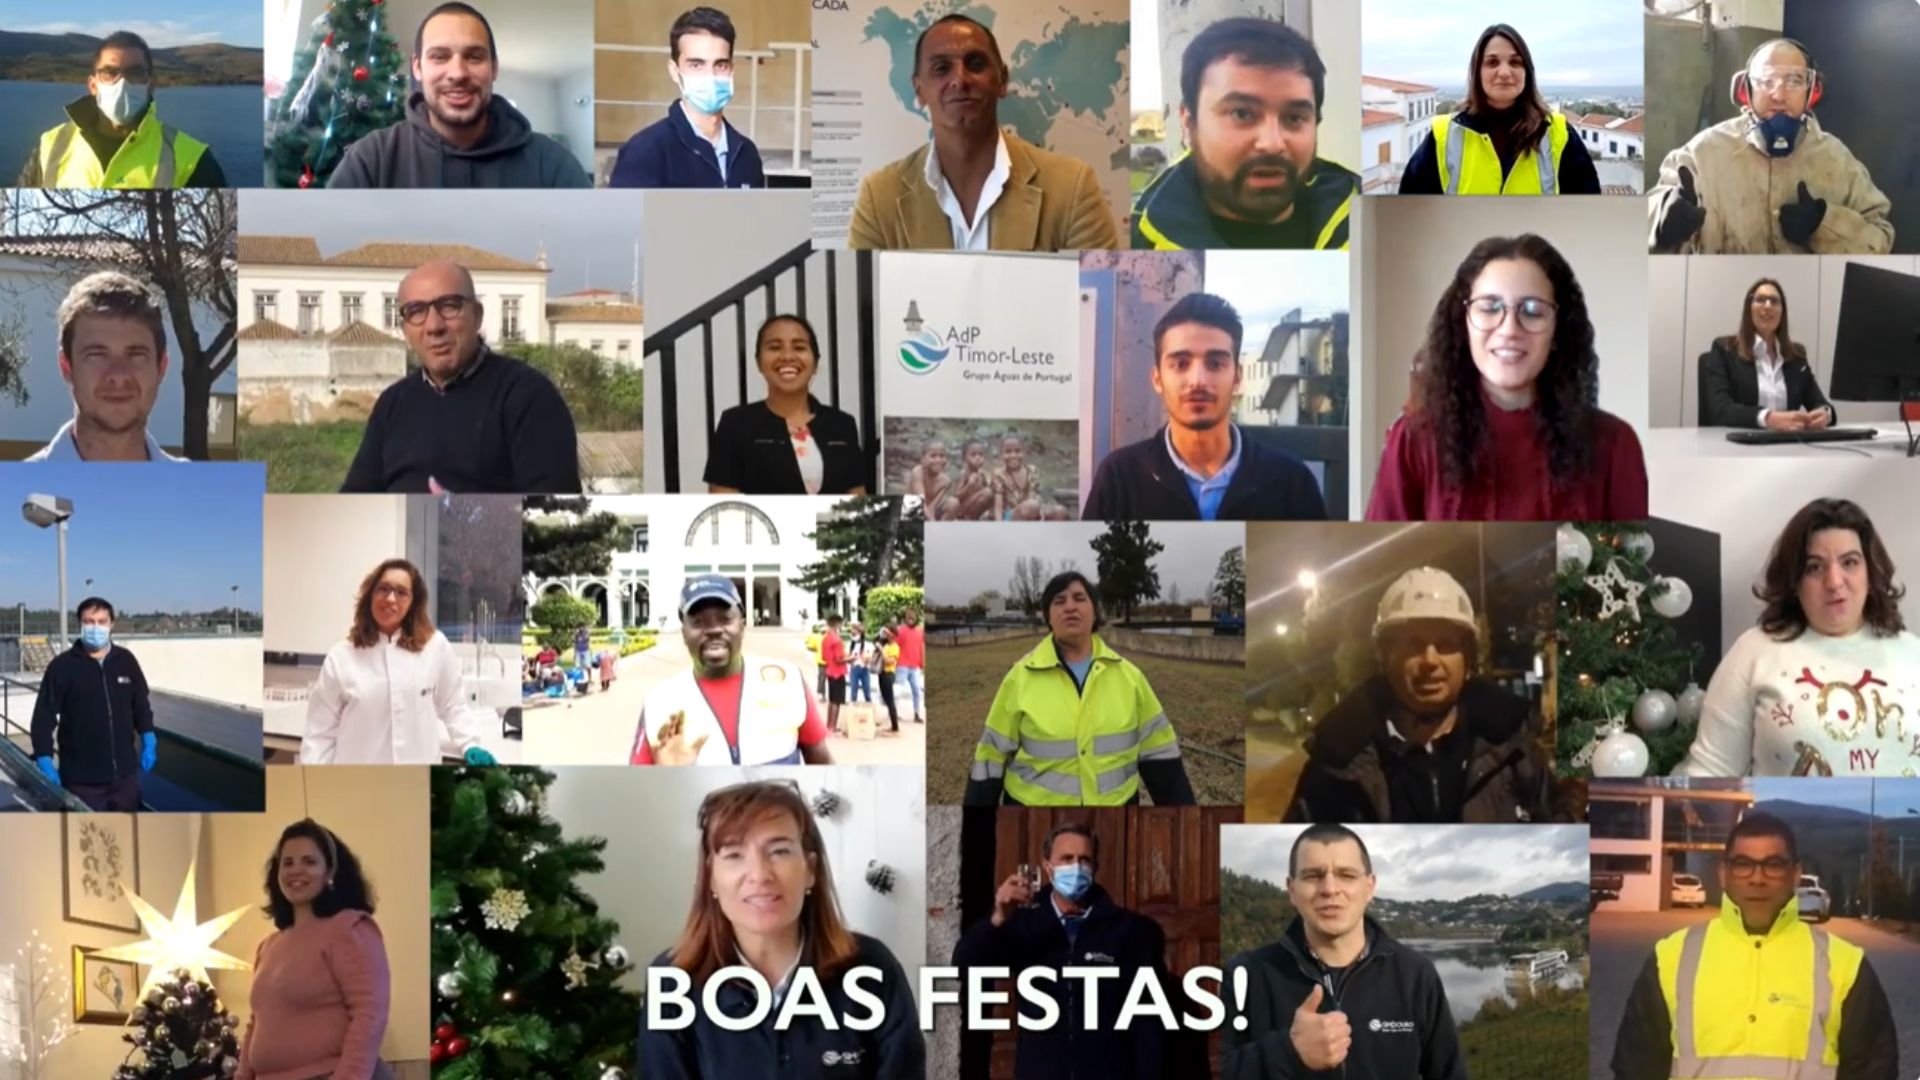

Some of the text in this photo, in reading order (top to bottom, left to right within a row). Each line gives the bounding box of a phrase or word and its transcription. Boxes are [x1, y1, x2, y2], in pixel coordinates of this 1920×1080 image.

[946, 326, 980, 343] AdP
[956, 345, 1055, 365] Timor-Leste
[963, 370, 991, 382] Grupo
[1022, 372, 1033, 382] de
[1035, 372, 1072, 385] Portugal
[1850, 750, 1879, 770] MY
